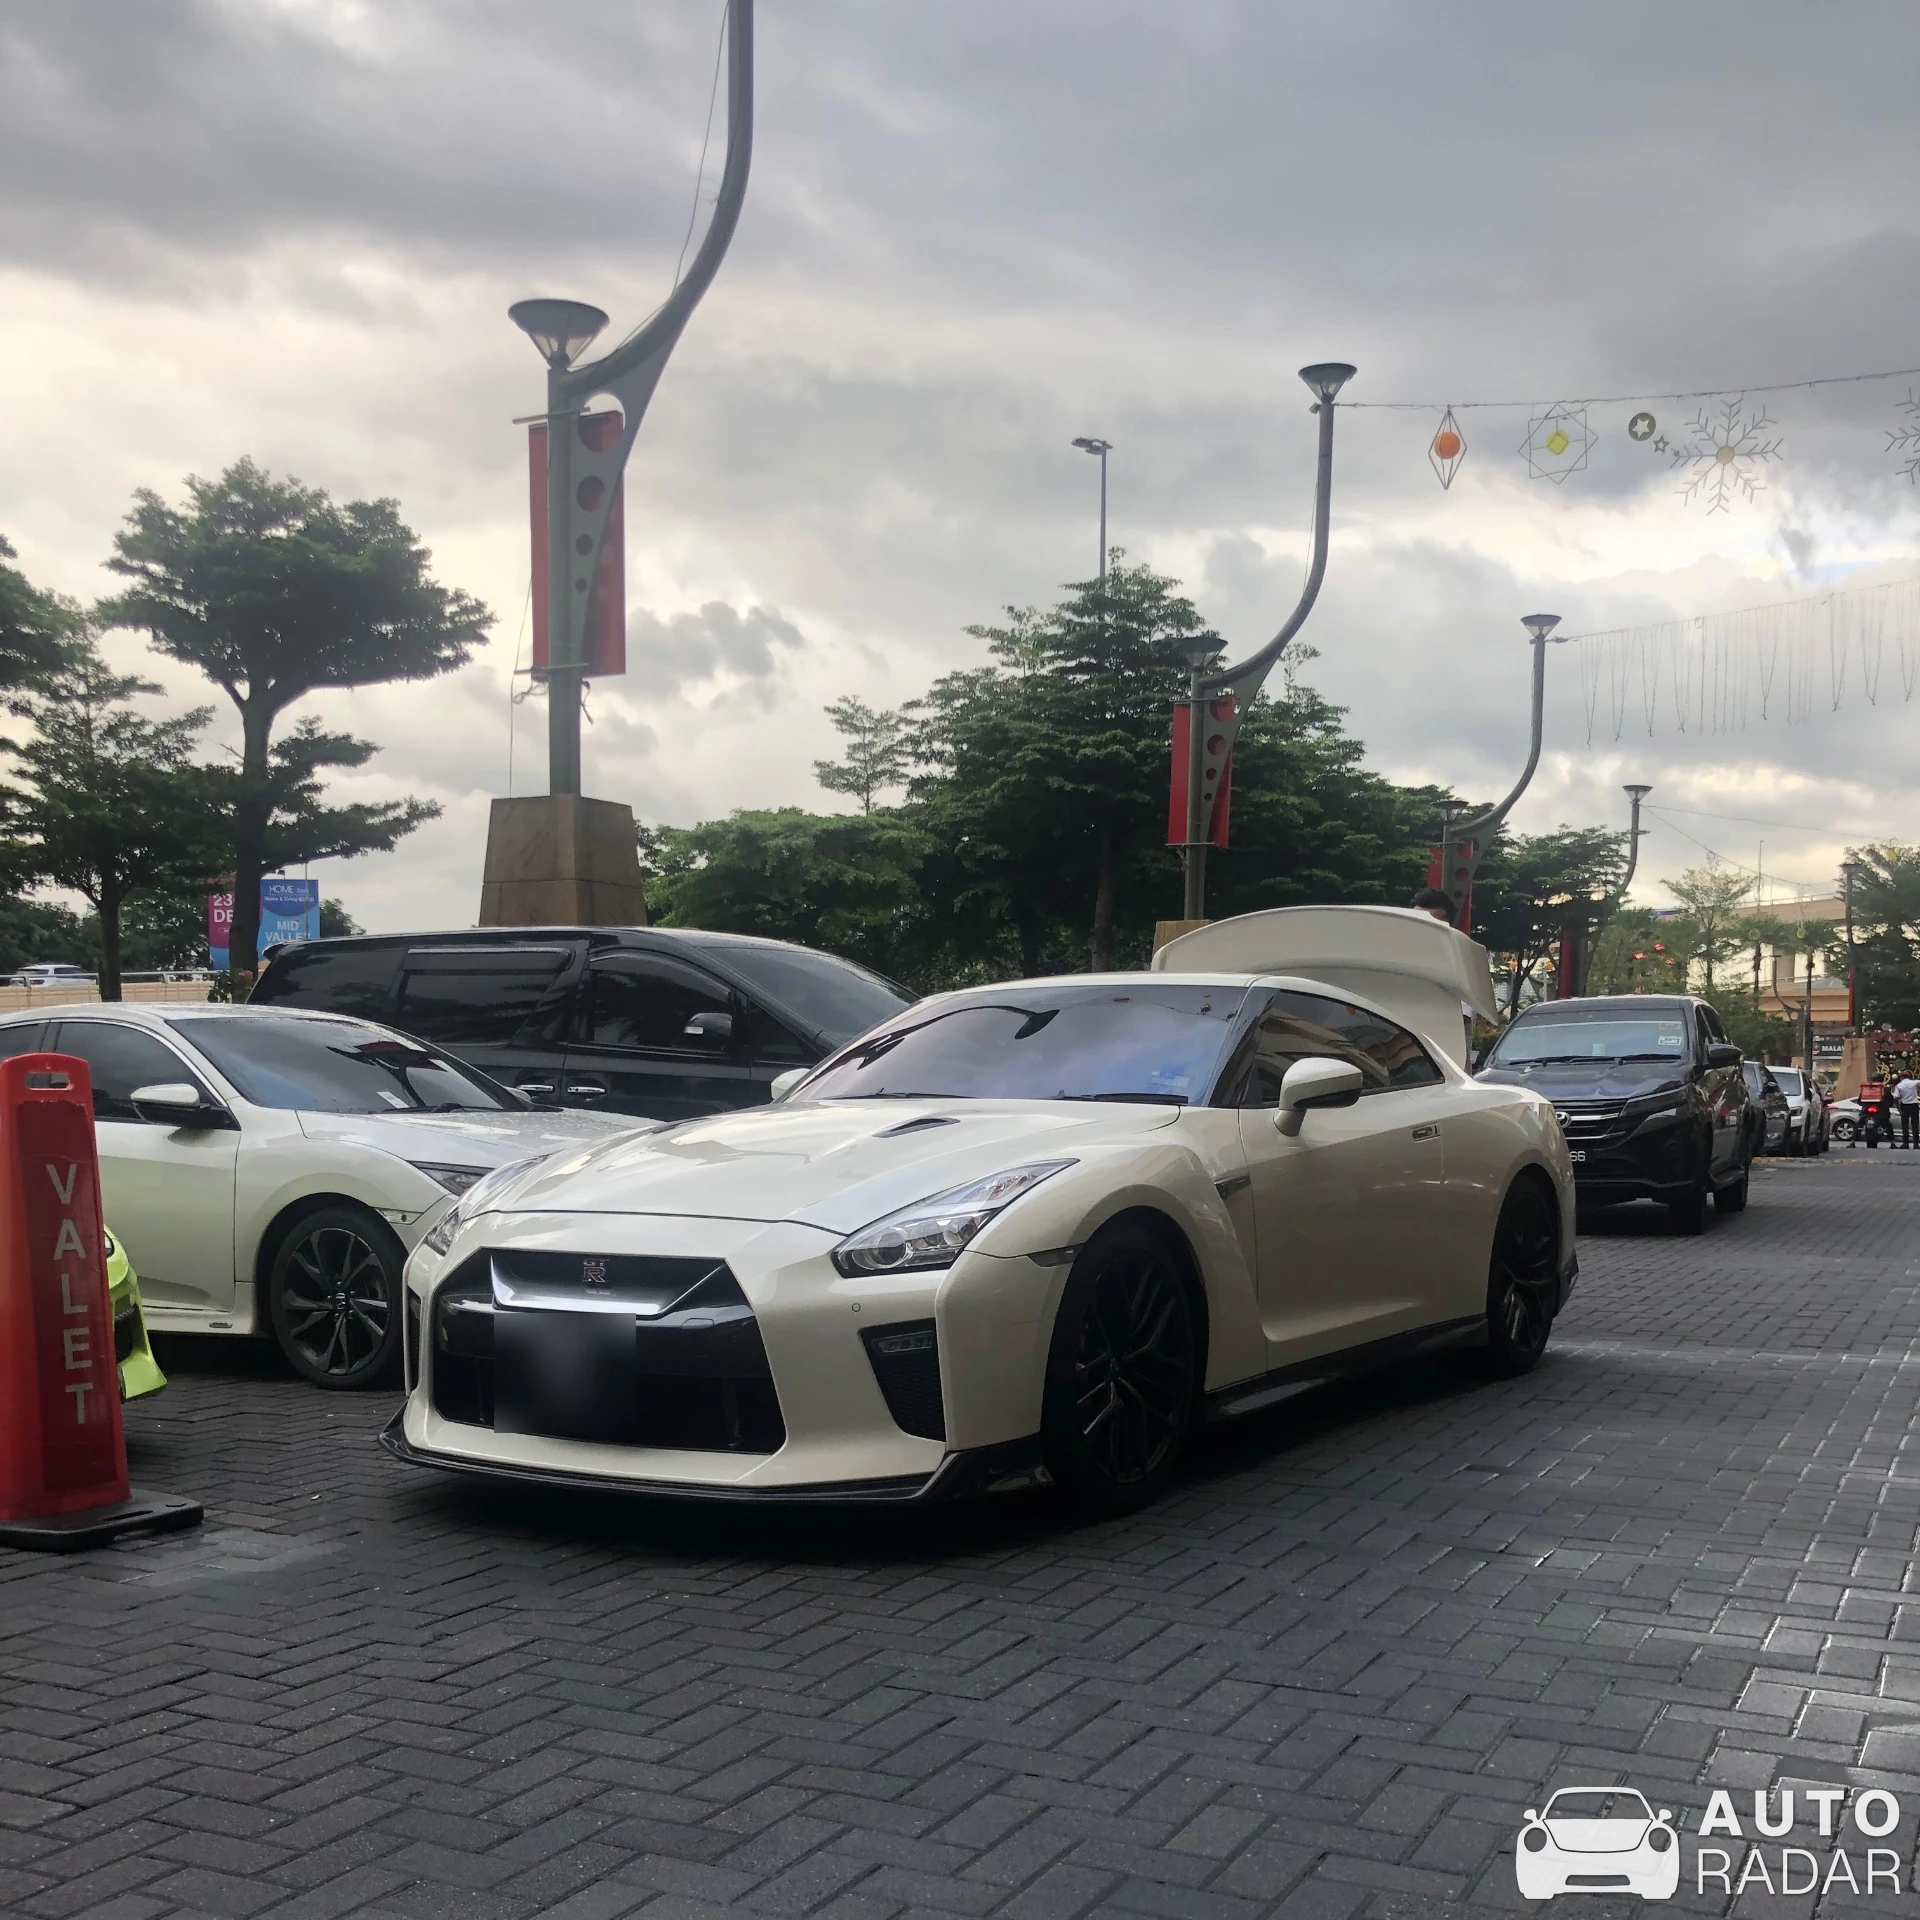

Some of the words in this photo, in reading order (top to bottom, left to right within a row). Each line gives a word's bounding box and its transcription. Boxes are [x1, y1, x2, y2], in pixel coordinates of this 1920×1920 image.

[269, 885, 294, 894] HOME
[276, 920, 300, 931] MID
[46, 1163, 93, 1425] VALET
